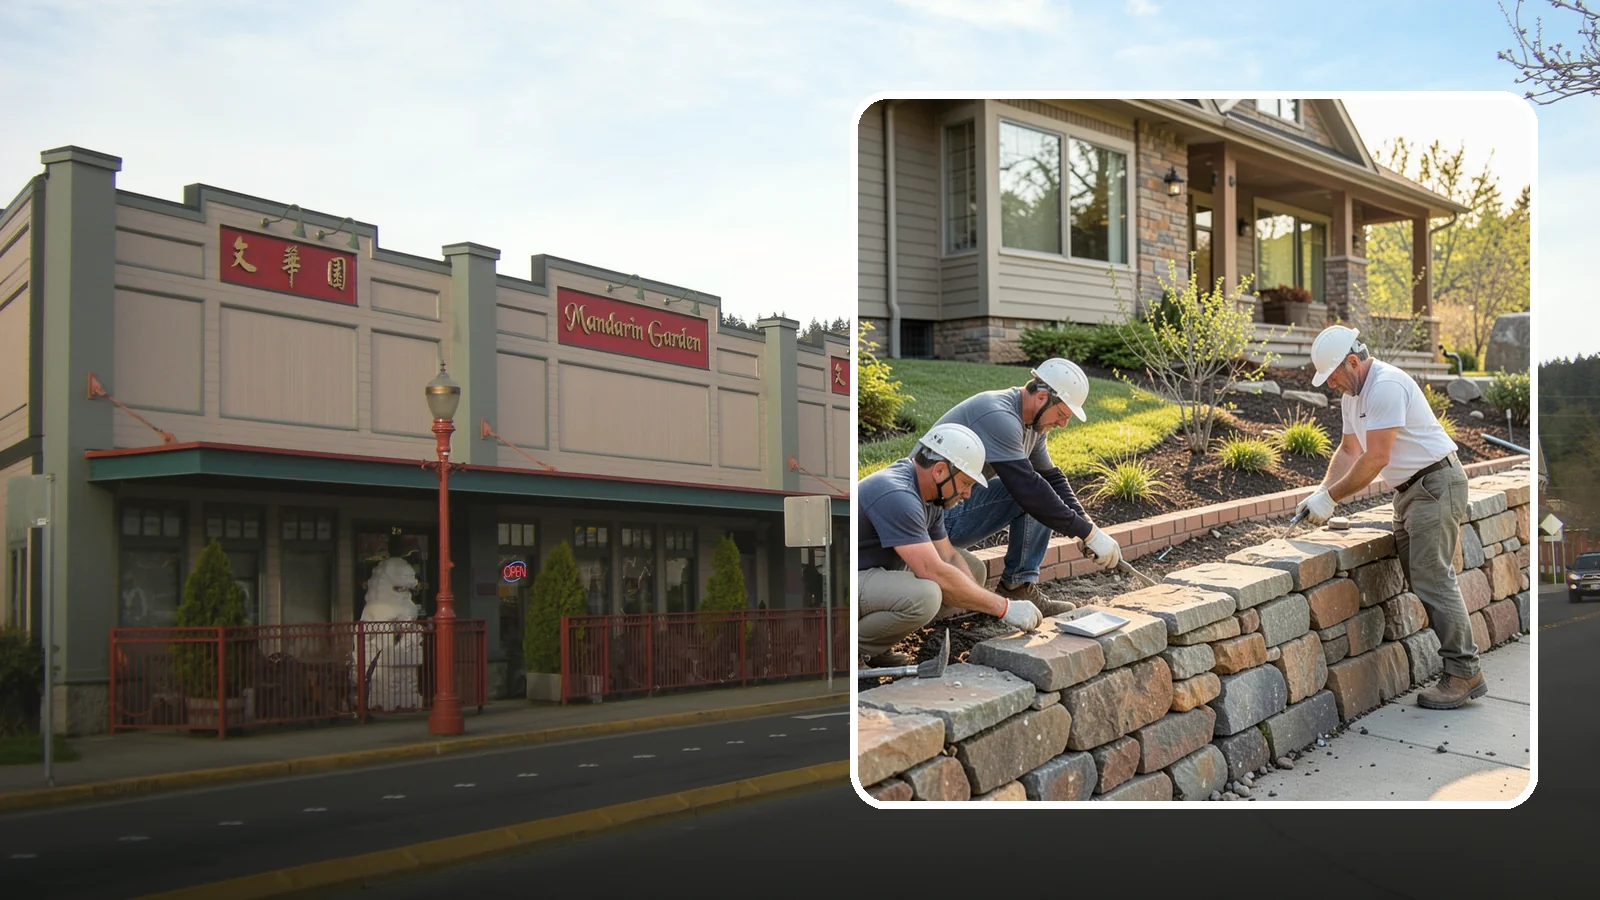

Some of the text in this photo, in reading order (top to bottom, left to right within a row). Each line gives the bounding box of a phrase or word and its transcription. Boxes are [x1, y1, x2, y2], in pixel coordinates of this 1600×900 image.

[230, 235, 346, 291] 文華園
[564, 302, 702, 352] Mandarin Garden
[503, 565, 527, 578] OPEN
